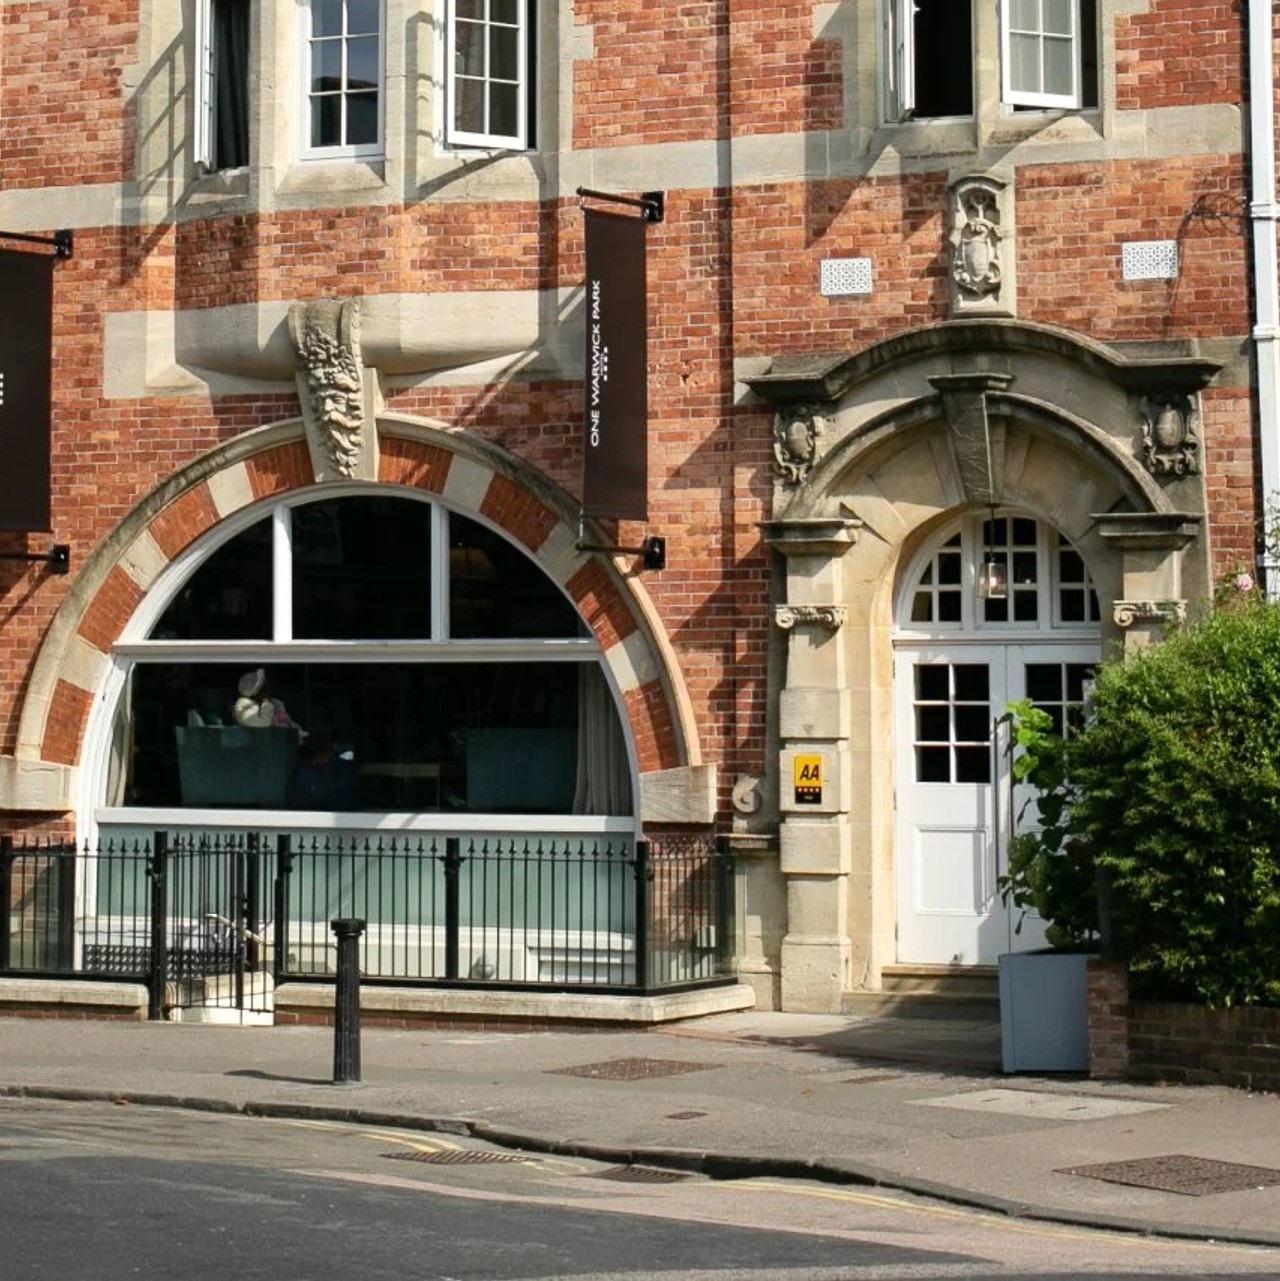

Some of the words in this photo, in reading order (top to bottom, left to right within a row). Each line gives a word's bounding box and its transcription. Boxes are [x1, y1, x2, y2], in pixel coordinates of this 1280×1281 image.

[592, 280, 601, 319] PARK
[591, 324, 601, 406] WARWICK
[591, 410, 600, 447] ONE
[799, 764, 819, 781] AA
